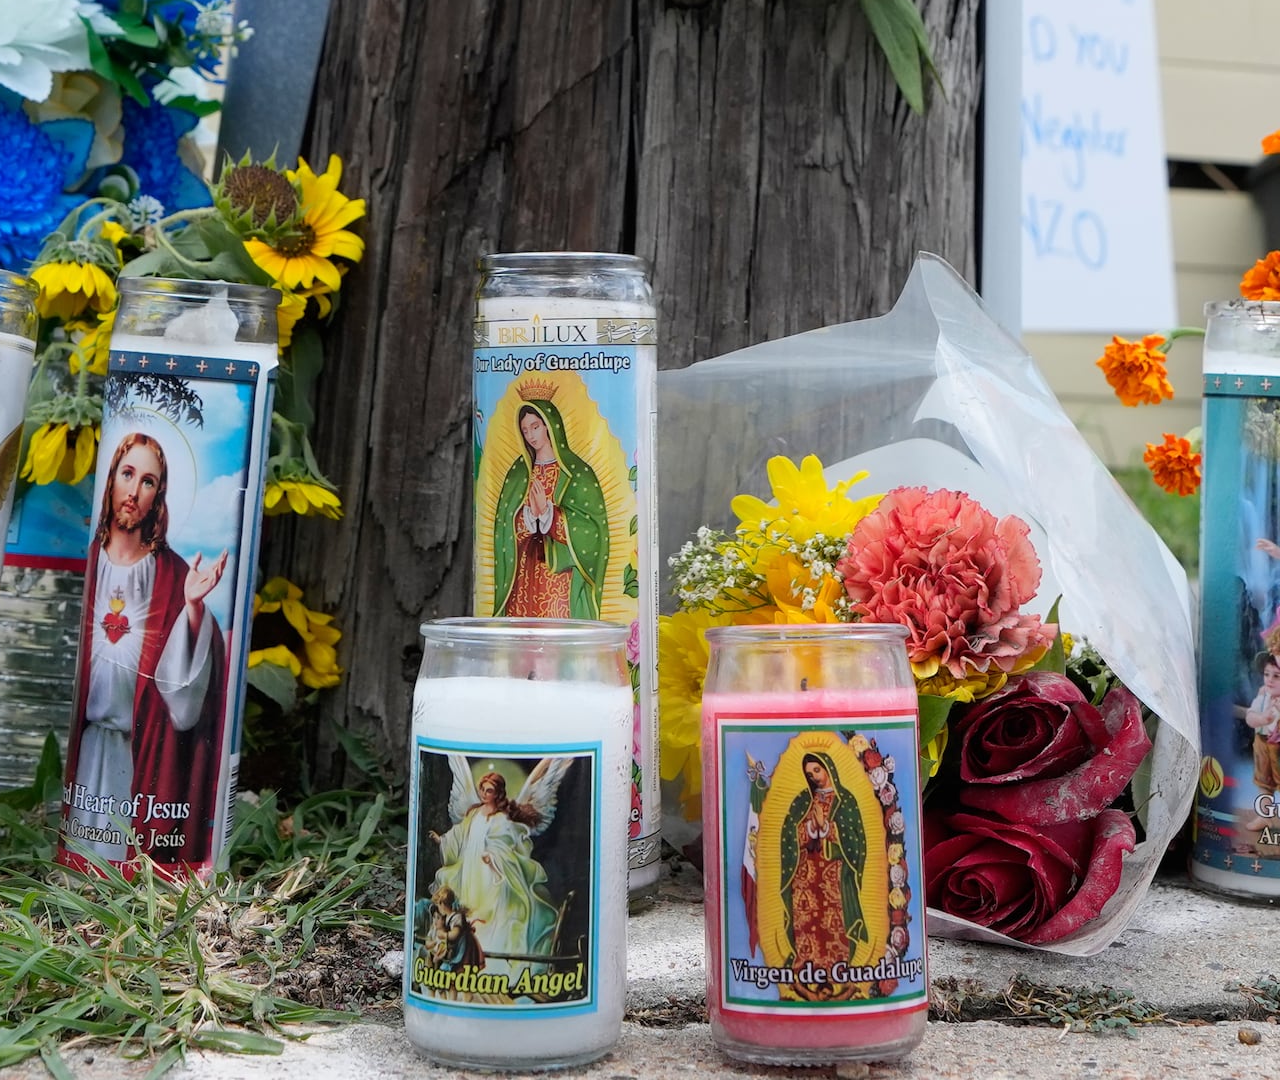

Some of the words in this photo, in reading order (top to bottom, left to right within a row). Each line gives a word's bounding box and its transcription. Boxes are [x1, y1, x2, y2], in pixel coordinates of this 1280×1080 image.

[475, 357, 490, 372] Our
[491, 353, 521, 375] Lady
[524, 352, 545, 370] of
[547, 351, 631, 374] Guadalupe
[73, 784, 116, 815] Heart
[120, 793, 143, 818] of
[143, 795, 190, 823] Jesus
[70, 818, 122, 845] Corazón
[125, 827, 144, 846] de
[147, 828, 186, 851] Jesús
[412, 957, 509, 994] Guardian
[512, 962, 584, 997] Angel
[730, 957, 795, 989] Virgen
[798, 959, 827, 983] de
[831, 956, 924, 983] Guadalupe
